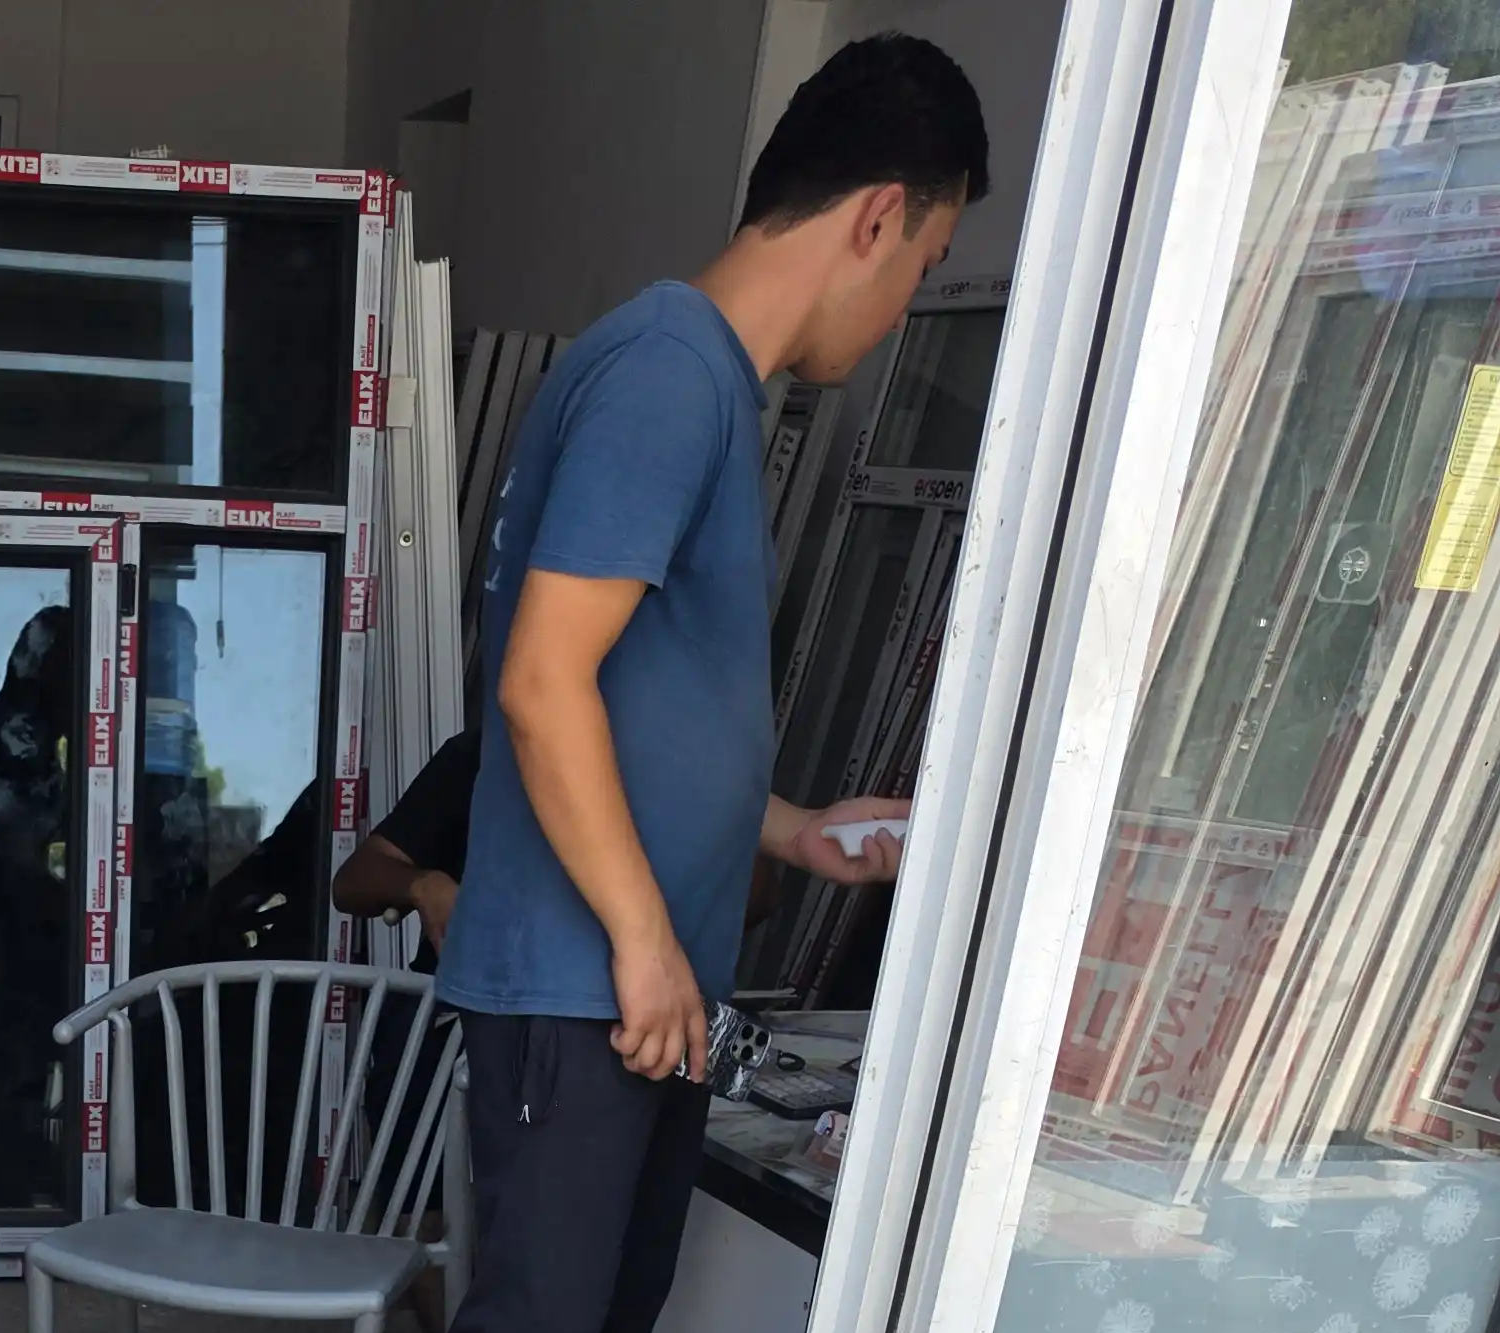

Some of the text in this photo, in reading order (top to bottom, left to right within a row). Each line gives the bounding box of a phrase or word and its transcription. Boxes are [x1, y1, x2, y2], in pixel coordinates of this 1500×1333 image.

[182, 165, 228, 185] ELIX
[358, 374, 373, 425] ELIX
[914, 477, 964, 501] erspen
[227, 509, 271, 527] ELIX
[350, 580, 364, 629] ELIX
[95, 715, 109, 765] ELIX
[340, 781, 355, 828] ELIX
[91, 914, 105, 962] ELIX
[331, 985, 345, 1020] ELI
[88, 1105, 102, 1150] ELIX
